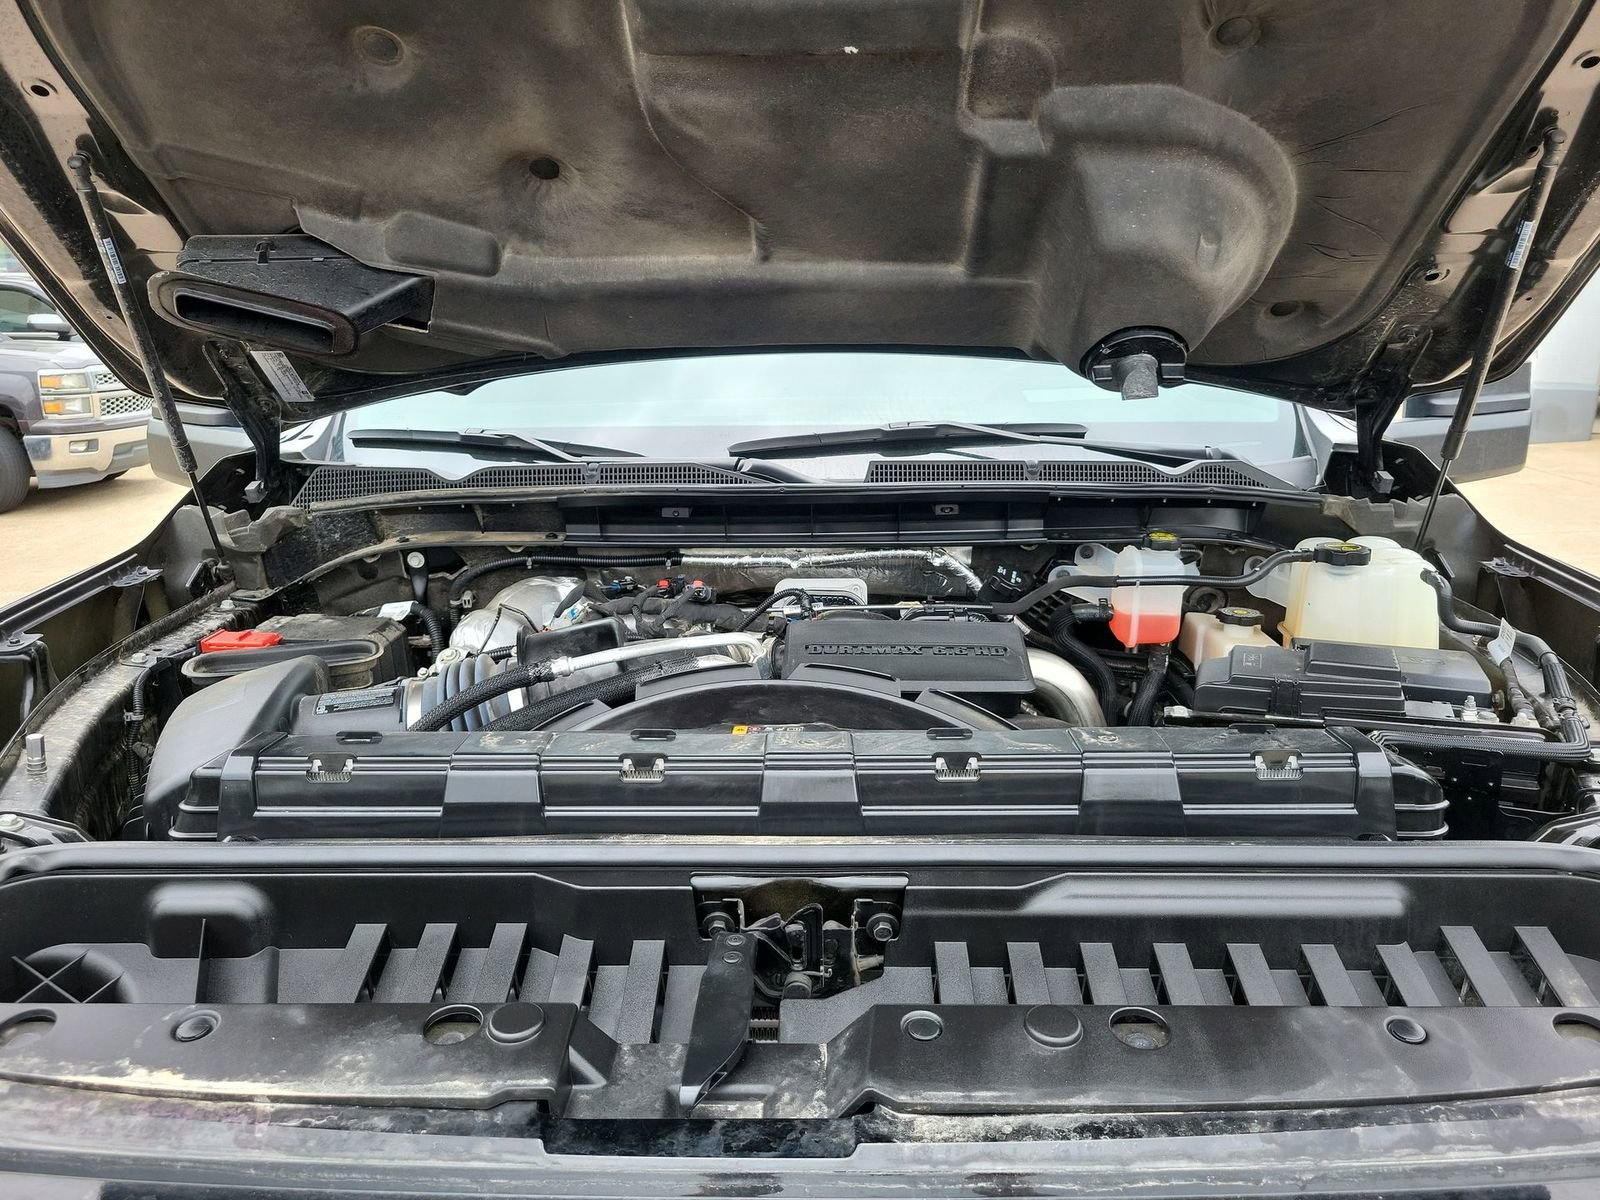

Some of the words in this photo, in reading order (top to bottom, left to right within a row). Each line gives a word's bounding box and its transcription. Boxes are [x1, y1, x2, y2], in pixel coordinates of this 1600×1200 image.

[806, 644, 923, 656] DURAMAX
[932, 645, 969, 656] 6.6
[975, 645, 1006, 657] HD
